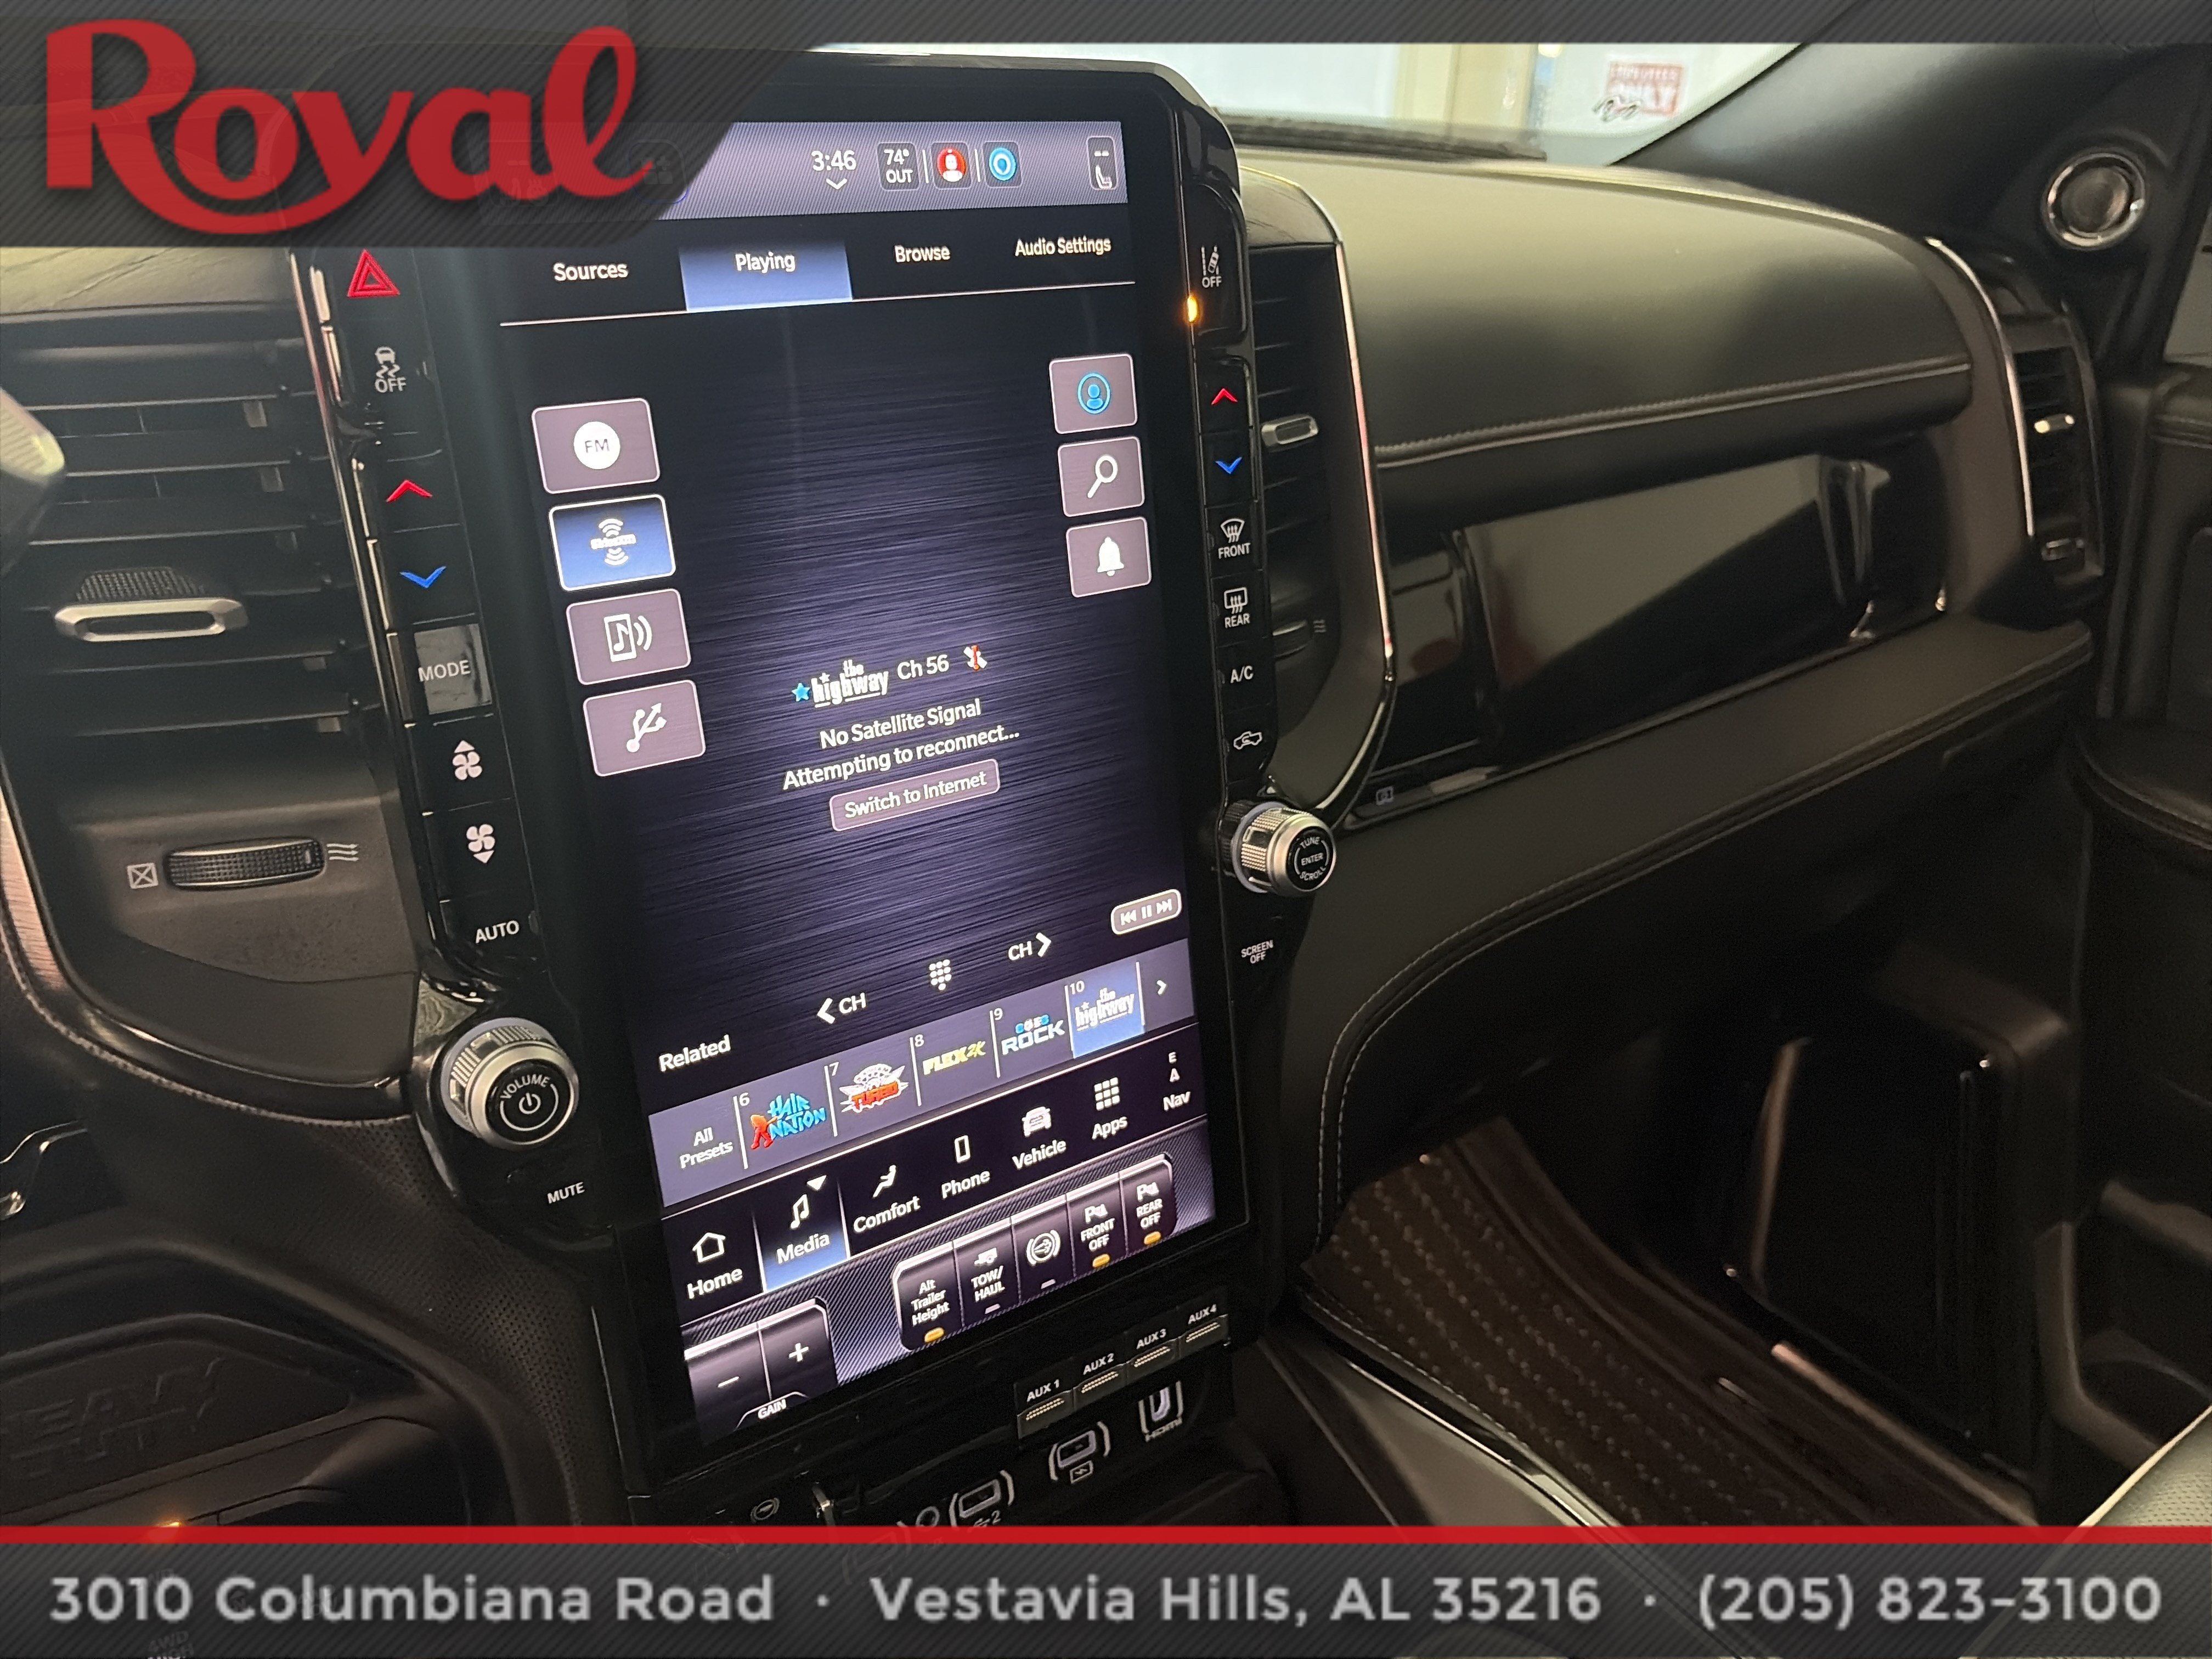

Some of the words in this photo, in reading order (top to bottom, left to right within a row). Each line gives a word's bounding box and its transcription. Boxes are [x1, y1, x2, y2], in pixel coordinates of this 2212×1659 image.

[811, 150, 856, 171] 3:46
[884, 149, 909, 165] 74°
[886, 169, 913, 183] OUT
[895, 245, 950, 262] Browse
[1015, 239, 1055, 257] Audio
[1057, 236, 1111, 256] Settings
[554, 263, 628, 281] Sources
[736, 252, 795, 273] Playing
[1201, 276, 1222, 288] OFF
[375, 377, 406, 393] OFF
[584, 438, 610, 454] FM
[1218, 543, 1251, 560] FRONT
[1224, 614, 1250, 629] REAR
[418, 659, 471, 682] MODE
[843, 659, 864, 678] the
[1230, 665, 1254, 684] A/C
[811, 670, 889, 705] highway
[897, 659, 923, 680] Ch
[926, 654, 950, 675] 56
[820, 730, 849, 749] No
[851, 713, 925, 743] Satellite
[927, 698, 981, 726] Signal
[782, 753, 891, 791] Attempting
[894, 748, 913, 765] to
[916, 725, 1020, 760] reconnect...
[845, 792, 901, 819] Switch
[905, 789, 921, 805] to
[924, 771, 987, 800] Internet
[1300, 837, 1321, 849] TUNE
[1301, 853, 1324, 866] ENTER
[1300, 866, 1327, 881] SCROLL
[475, 920, 520, 943] AUTO
[1008, 940, 1032, 962] CH
[1241, 940, 1274, 958] SCREEN
[1250, 951, 1266, 964] OFF
[1070, 980, 1085, 995] 10
[1099, 988, 1116, 1002] the
[839, 992, 867, 1015] CH
[994, 1007, 1003, 1020] 9
[1075, 992, 1136, 1028] highway
[915, 1034, 925, 1047] 8
[1001, 1020, 1065, 1056] ROCK
[658, 1035, 731, 1072] Related
[829, 1062, 840, 1076] 7
[500, 1074, 551, 1101] VOLUME
[739, 1092, 750, 1106] 6
[768, 1093, 811, 1118] HAIR
[1163, 1091, 1191, 1112] Nav
[768, 1108, 827, 1139] NATION
[1092, 1115, 1128, 1141] Apps
[693, 1126, 714, 1147] All
[679, 1141, 733, 1169] Presets
[1012, 1138, 1067, 1171] Vehicle
[548, 1181, 585, 1204] MUTE
[941, 1170, 991, 1199] Phone
[853, 1195, 921, 1233] Comfort
[1136, 1198, 1163, 1218] REAR
[1081, 1218, 1115, 1242] FRONT
[1141, 1213, 1161, 1229] OFF
[776, 1233, 831, 1264] Media
[1088, 1235, 1110, 1252] OFF
[687, 1268, 743, 1300] Home
[918, 1278, 936, 1295] Alt
[971, 1266, 1003, 1289] TOW/
[911, 1288, 947, 1312] Trailer
[974, 1283, 1006, 1301] HAUL
[912, 1302, 950, 1328] Height
[1188, 1307, 1210, 1324] AUX
[1209, 1304, 1217, 1314] 4
[1136, 1332, 1160, 1350] AUX
[1159, 1328, 1167, 1339] 3
[1083, 1357, 1107, 1375] AUX
[1106, 1353, 1115, 1363] 2
[1026, 1383, 1051, 1402] AUX
[1054, 1379, 1060, 1389] 1
[758, 1398, 788, 1420] GAIN
[991, 1509, 1002, 1525] 2
